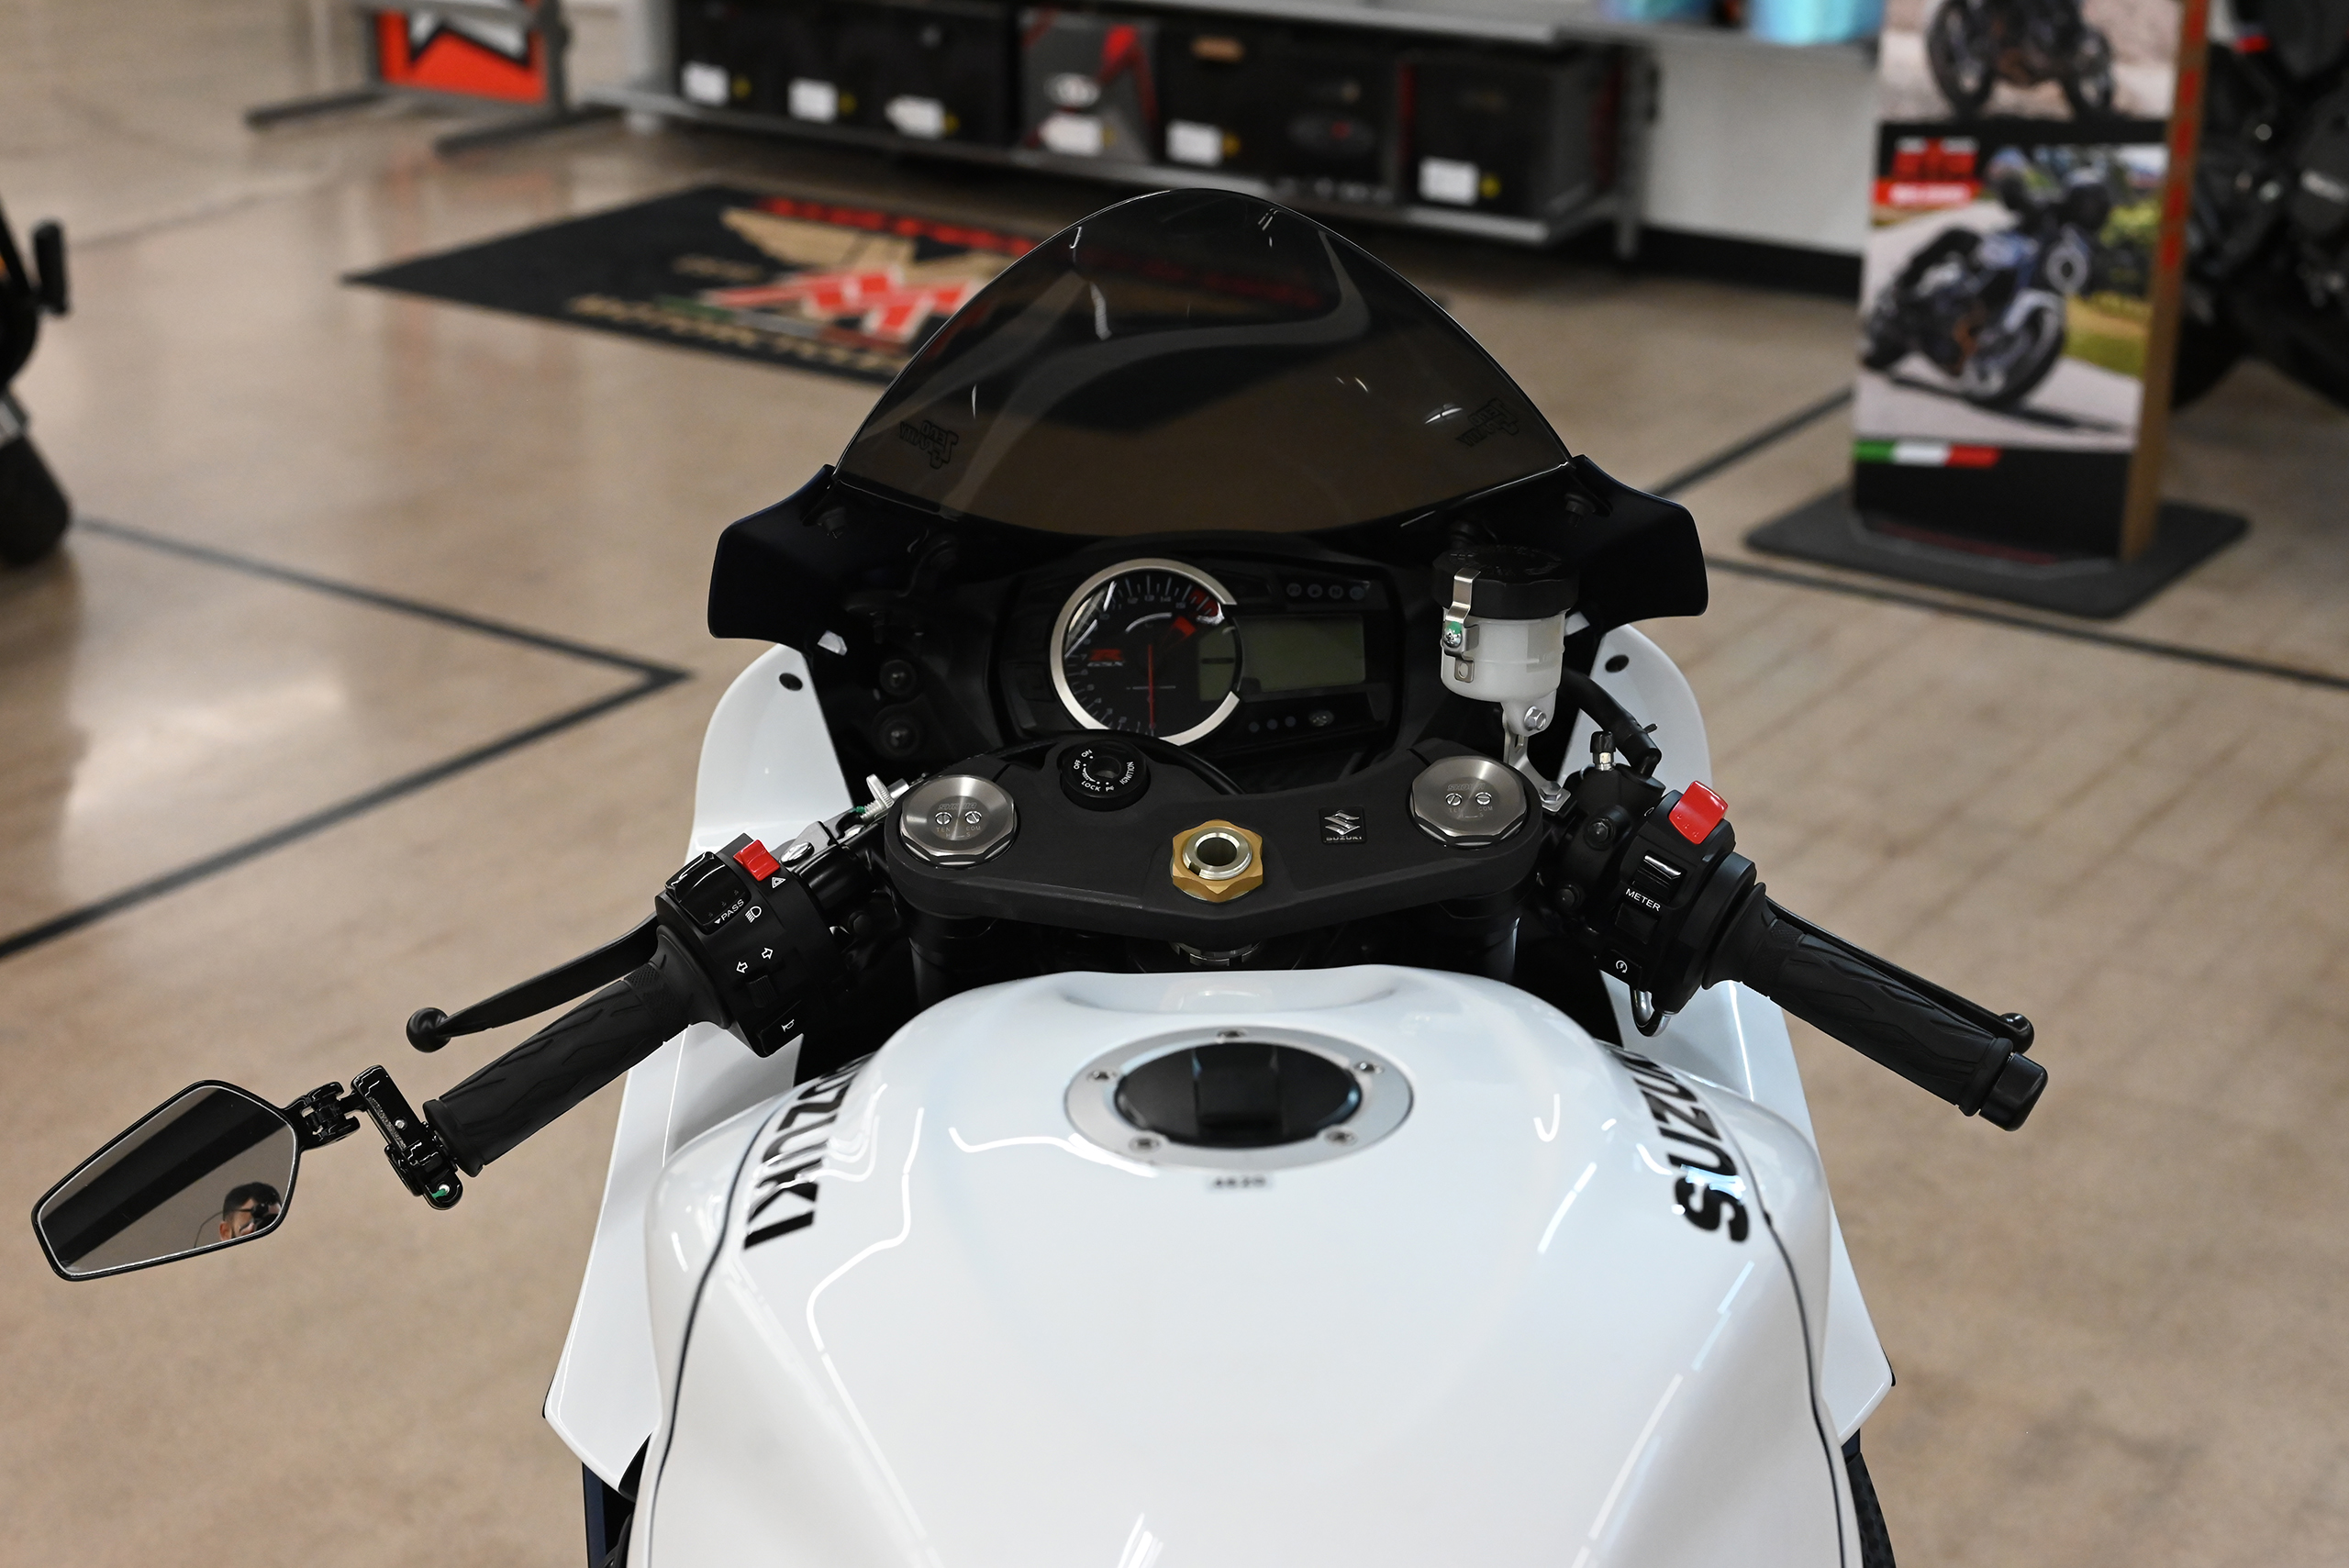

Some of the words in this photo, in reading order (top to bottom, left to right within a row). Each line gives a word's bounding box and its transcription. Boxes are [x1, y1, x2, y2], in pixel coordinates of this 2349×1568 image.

[1081, 749, 1093, 758] ON
[1073, 759, 1082, 770] OFF
[1119, 761, 1135, 785] IGNITION
[1081, 780, 1101, 792] LOCK
[1625, 887, 1661, 912] METER
[721, 898, 744, 921] PASS
